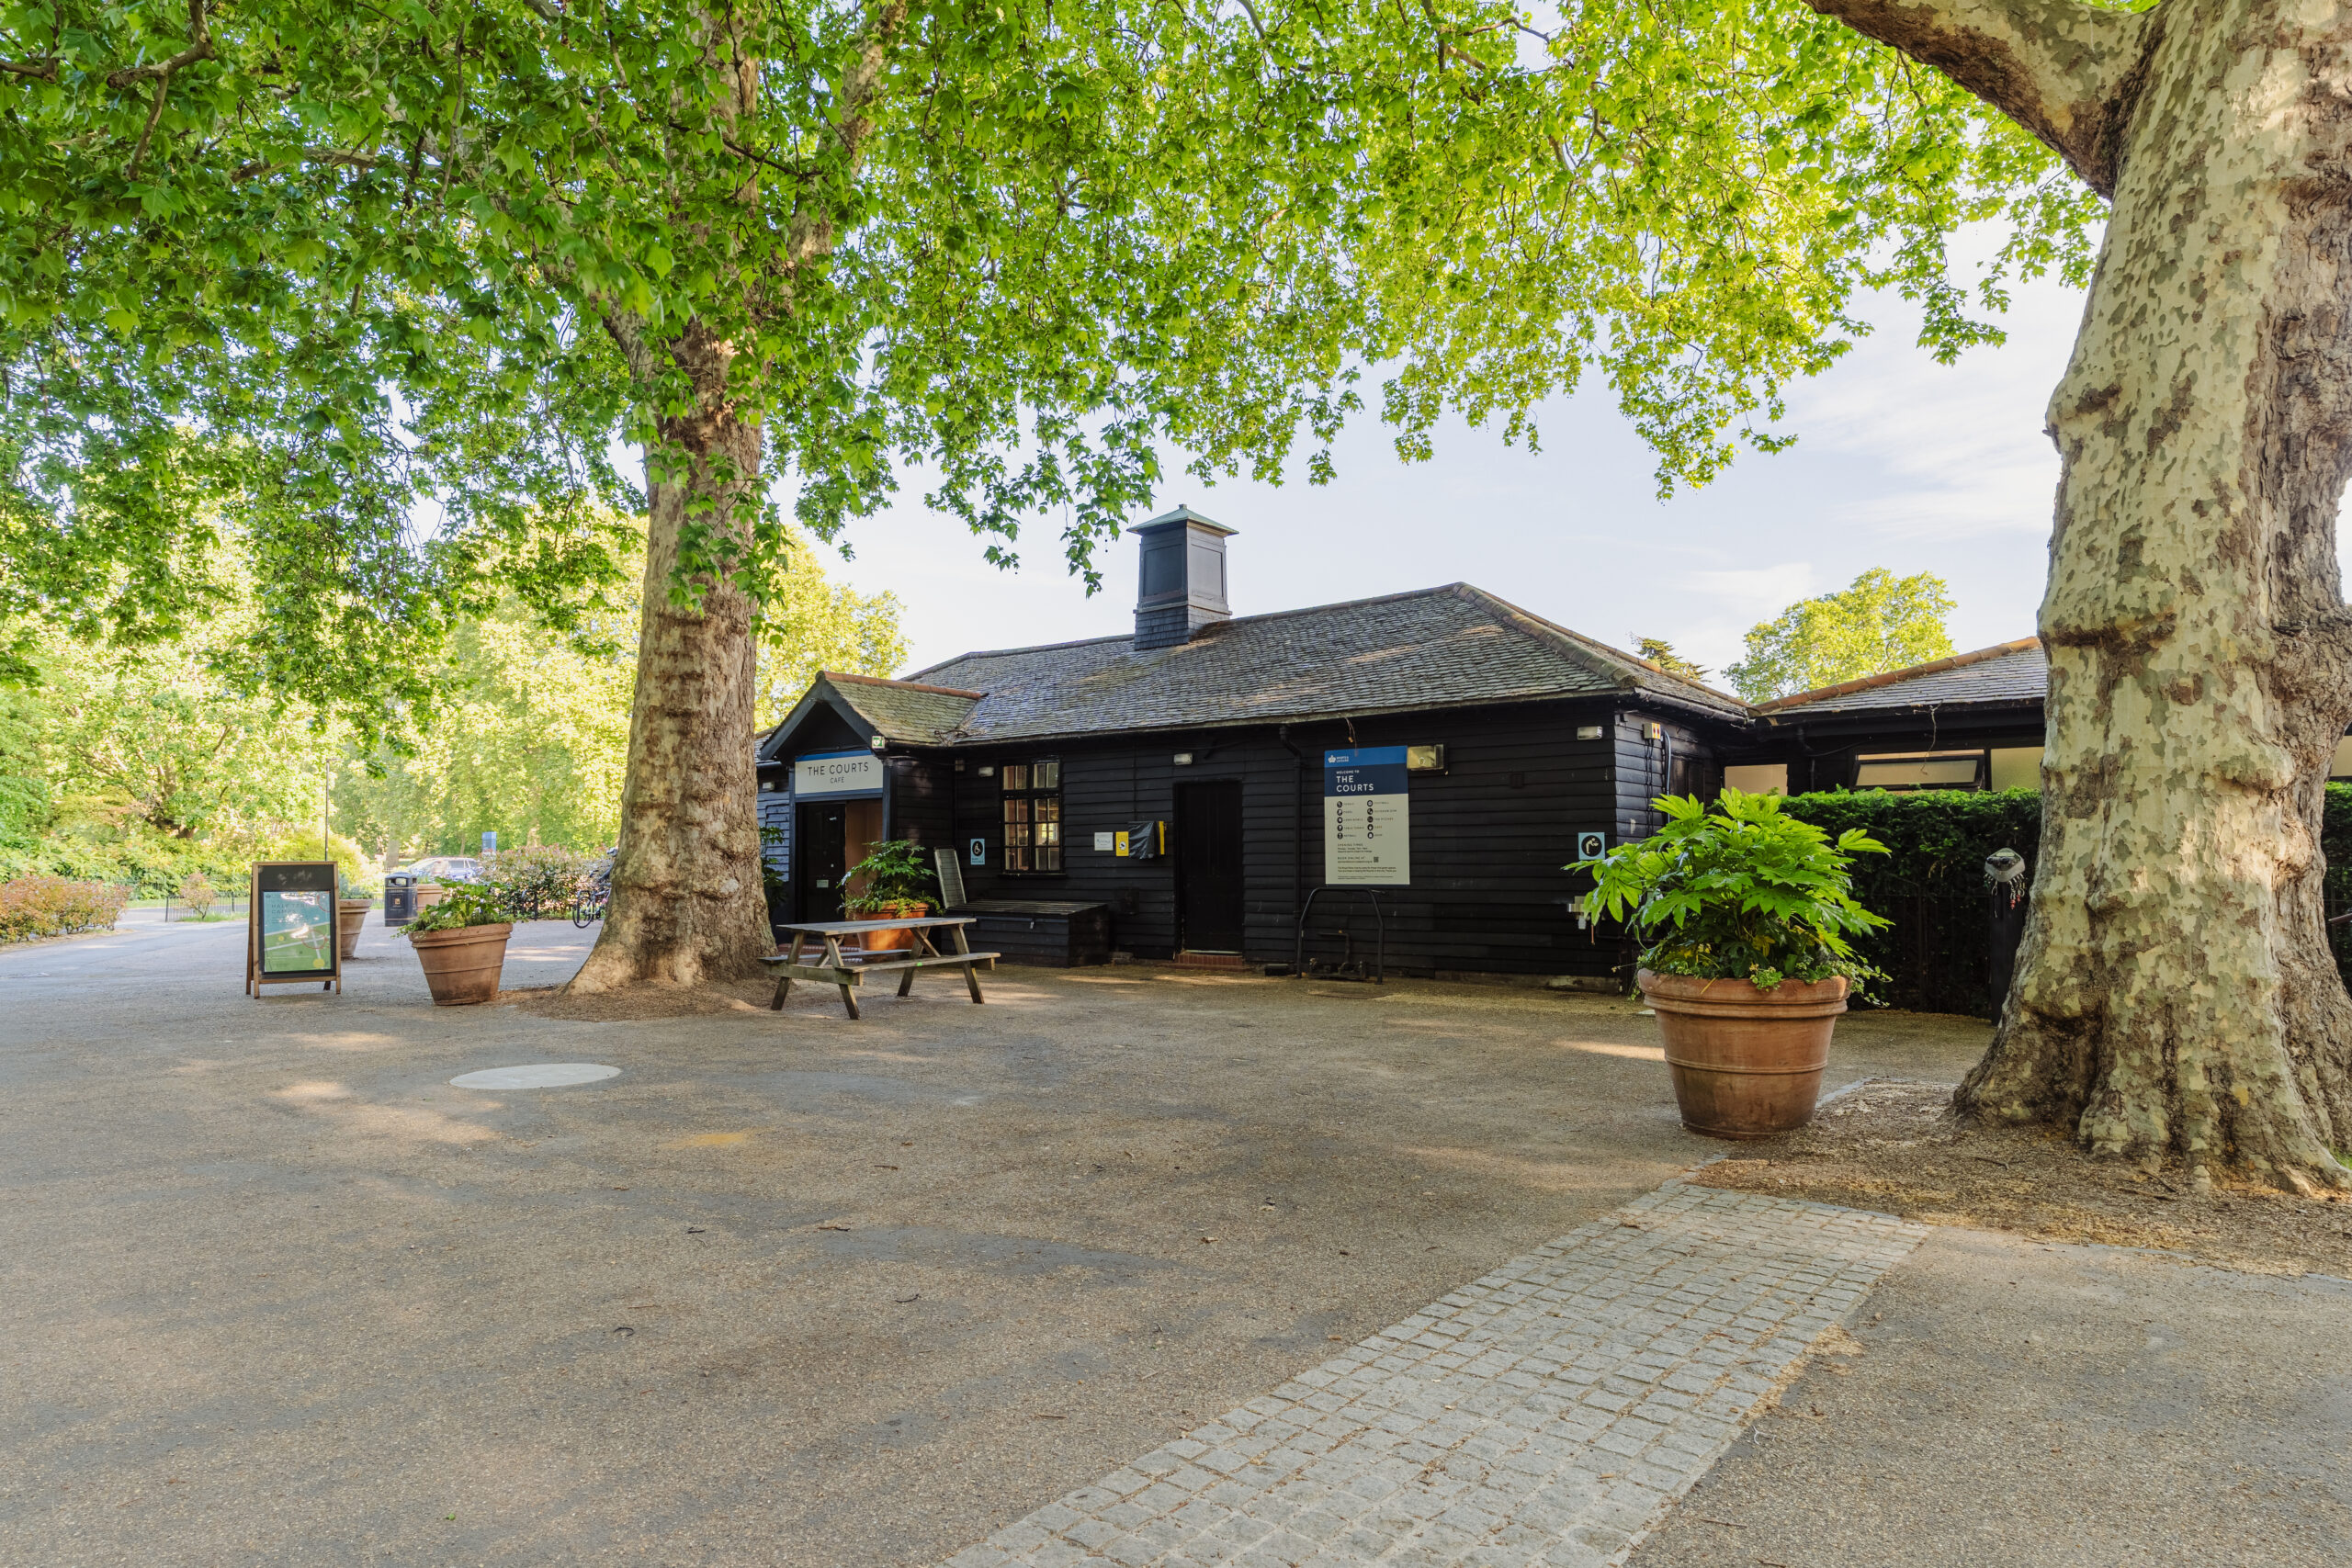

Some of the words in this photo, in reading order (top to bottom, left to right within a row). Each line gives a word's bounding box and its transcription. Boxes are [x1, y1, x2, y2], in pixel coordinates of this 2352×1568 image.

[808, 765, 825, 776] THE
[829, 761, 869, 774] COURTS
[830, 775, 845, 784] CAFÉ
[1336, 774, 1354, 783] THE
[1336, 784, 1374, 793] COURTS
